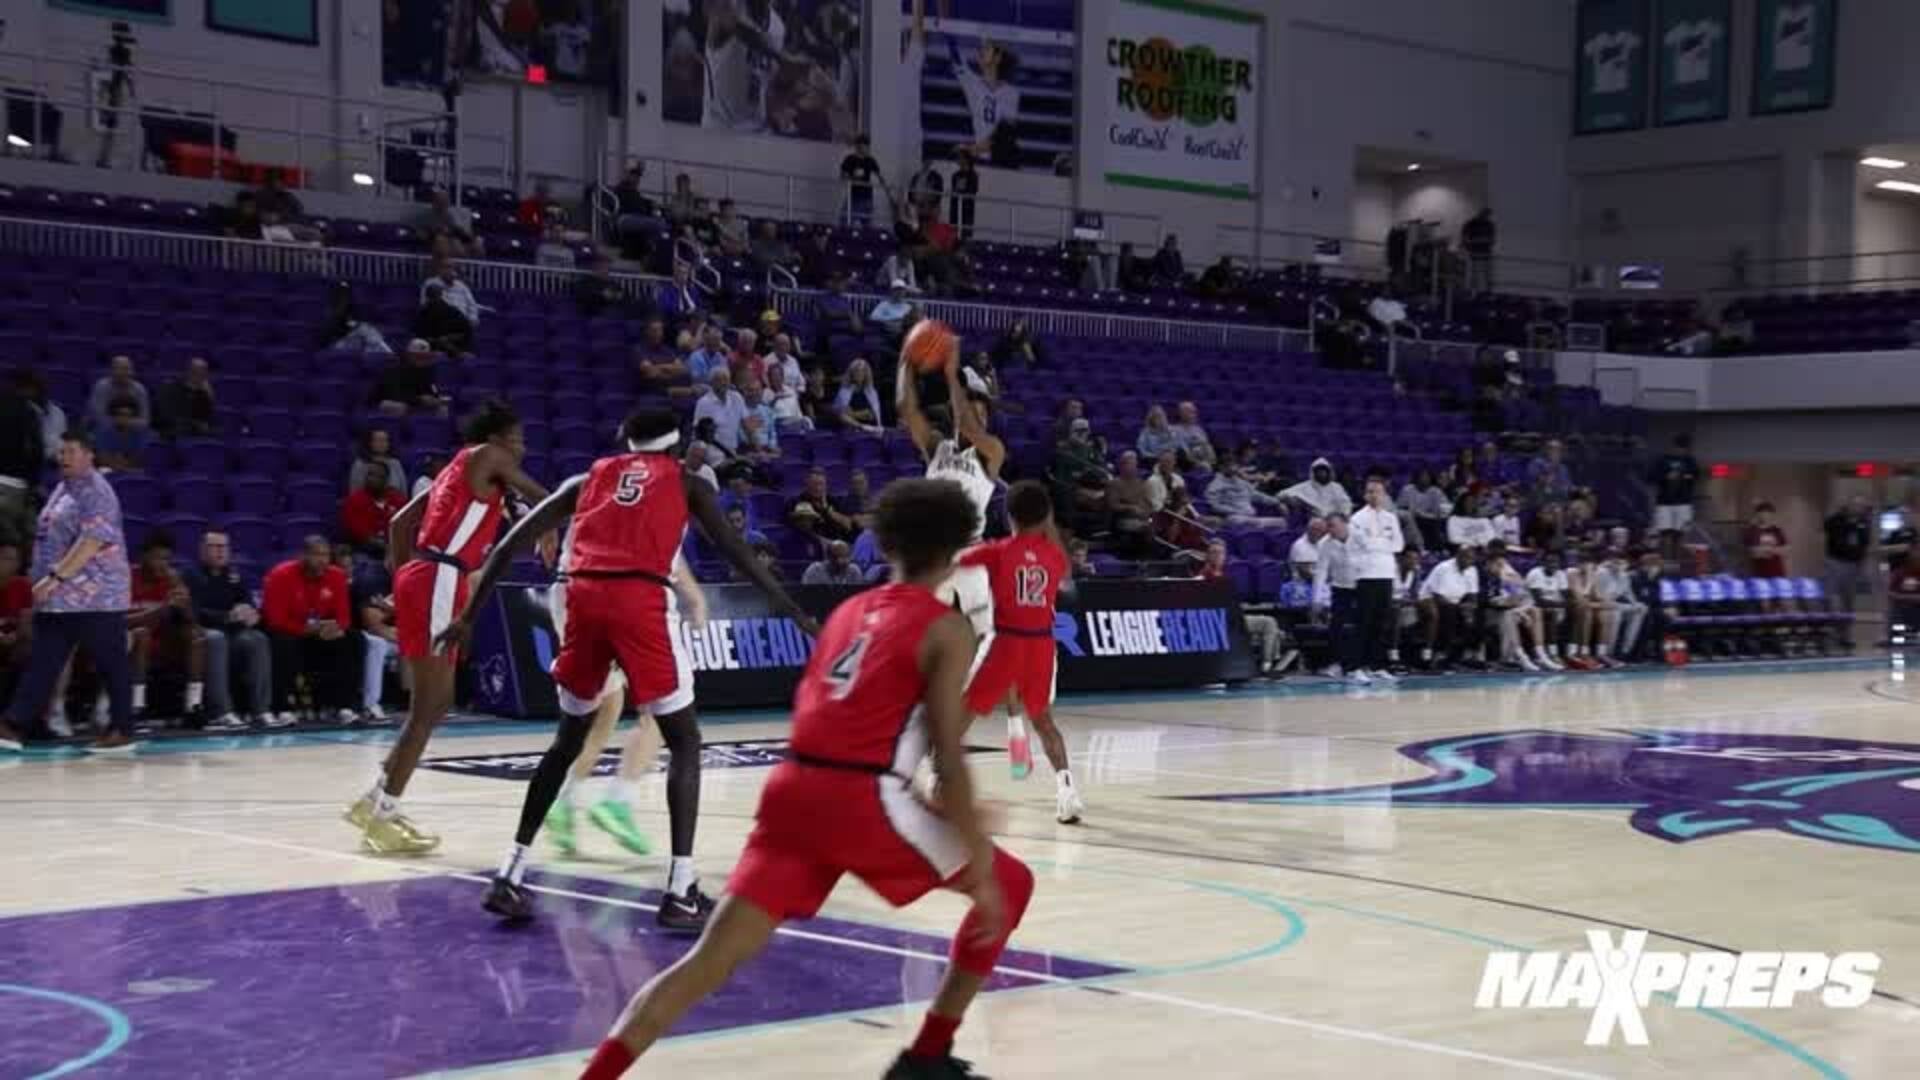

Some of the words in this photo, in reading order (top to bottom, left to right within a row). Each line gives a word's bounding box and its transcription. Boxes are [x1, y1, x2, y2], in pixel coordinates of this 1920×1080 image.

[1106, 37, 1253, 92] CROWTHER
[1117, 76, 1238, 124] ROOFING
[612, 468, 650, 507] 5
[1015, 564, 1048, 607] 12
[1084, 607, 1231, 656] LEAGUEREADY
[821, 630, 874, 701] 4
